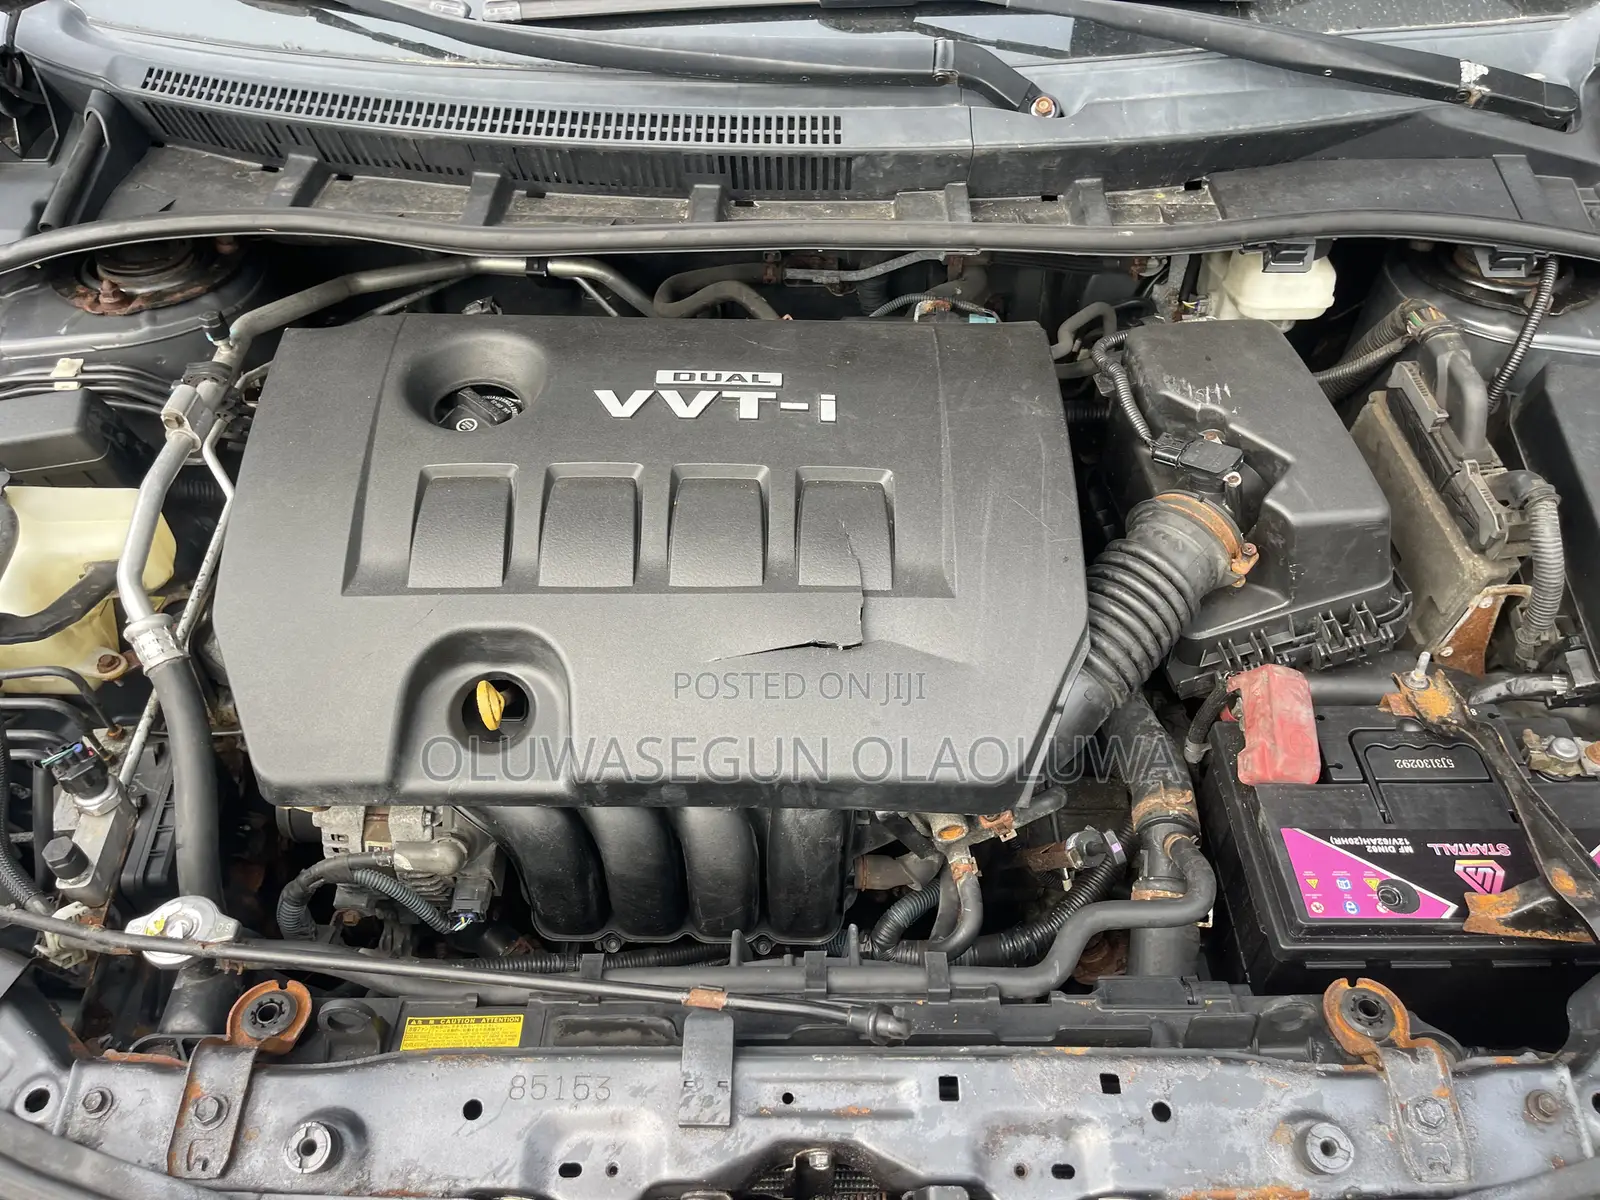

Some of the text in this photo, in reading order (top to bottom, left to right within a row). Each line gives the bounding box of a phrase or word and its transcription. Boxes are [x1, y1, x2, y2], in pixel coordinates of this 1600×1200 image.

[672, 371, 772, 384] DUAL
[593, 389, 837, 423] VVT-i
[1394, 757, 1455, 769] 5J3130292
[1329, 835, 1411, 846] 12V/62AH(20HR)
[1366, 845, 1414, 854] MF DIN62
[1426, 843, 1512, 857] STARTALL
[480, 1016, 520, 1024] ATTENTION
